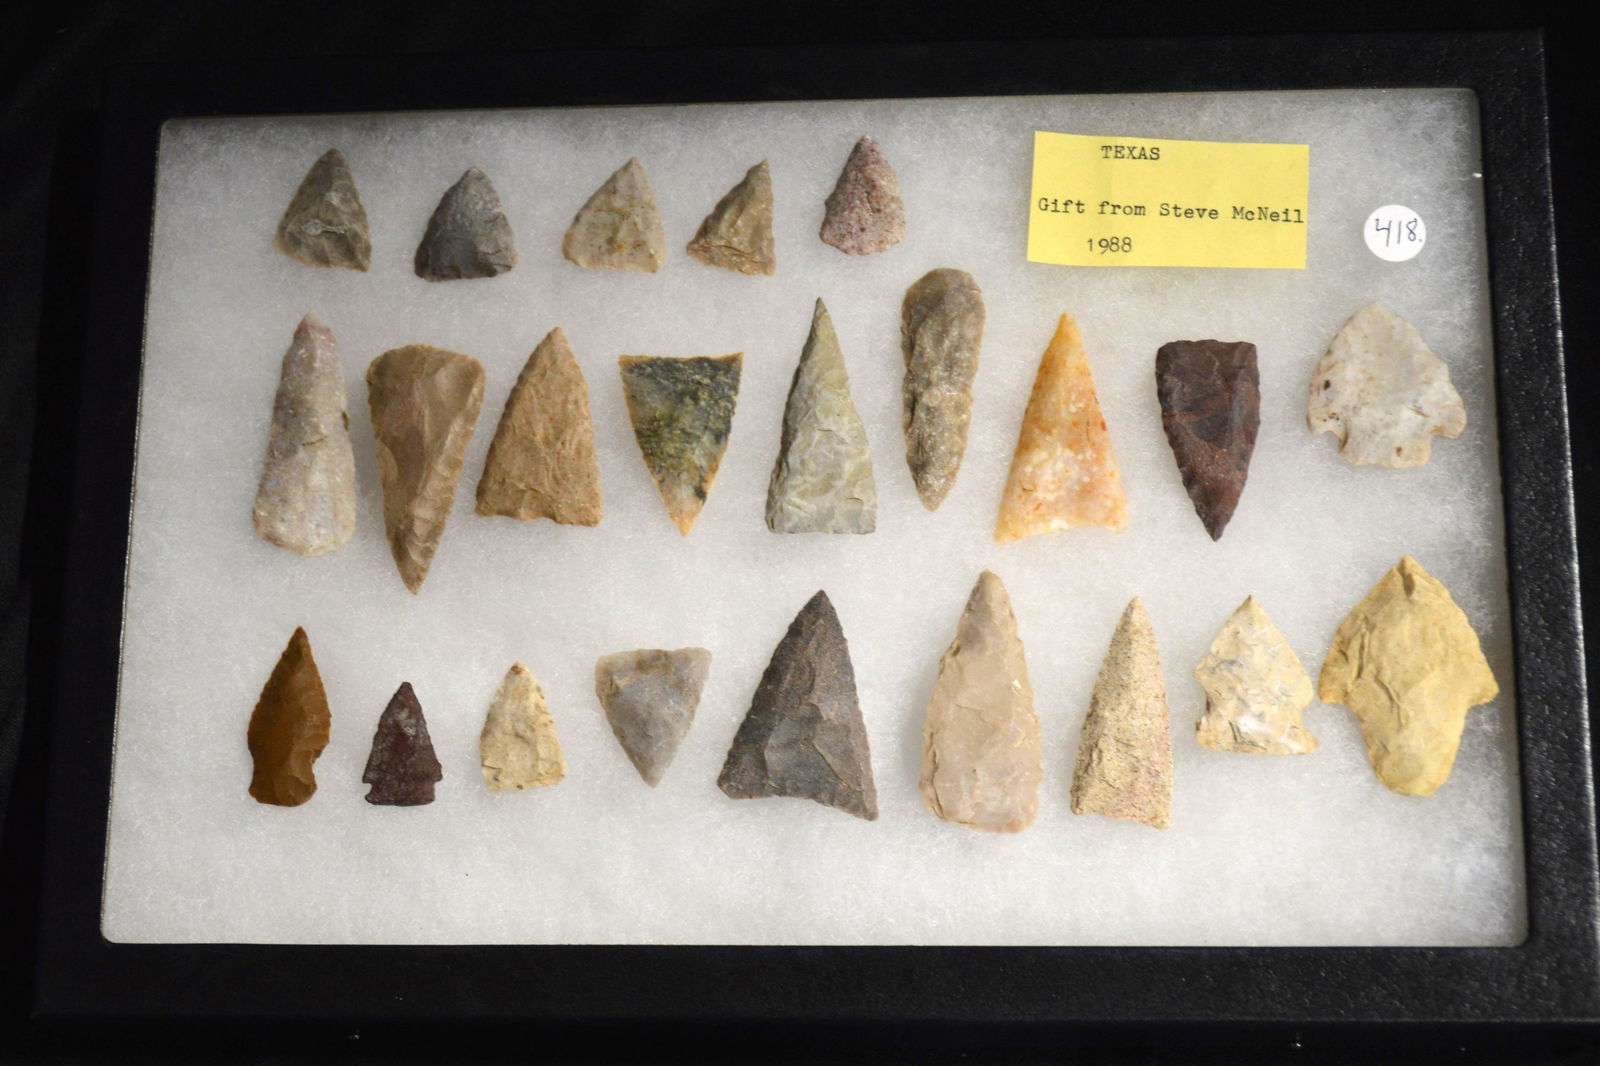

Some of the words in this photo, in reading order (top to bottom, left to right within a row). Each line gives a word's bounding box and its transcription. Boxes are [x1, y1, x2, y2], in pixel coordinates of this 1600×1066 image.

[1101, 145, 1161, 161] TEXAS
[1038, 198, 1086, 215] Gift
[1098, 200, 1146, 217] from
[1159, 203, 1219, 221] Steve
[1232, 205, 1304, 224] McNeil
[1086, 237, 1132, 255] 1988
